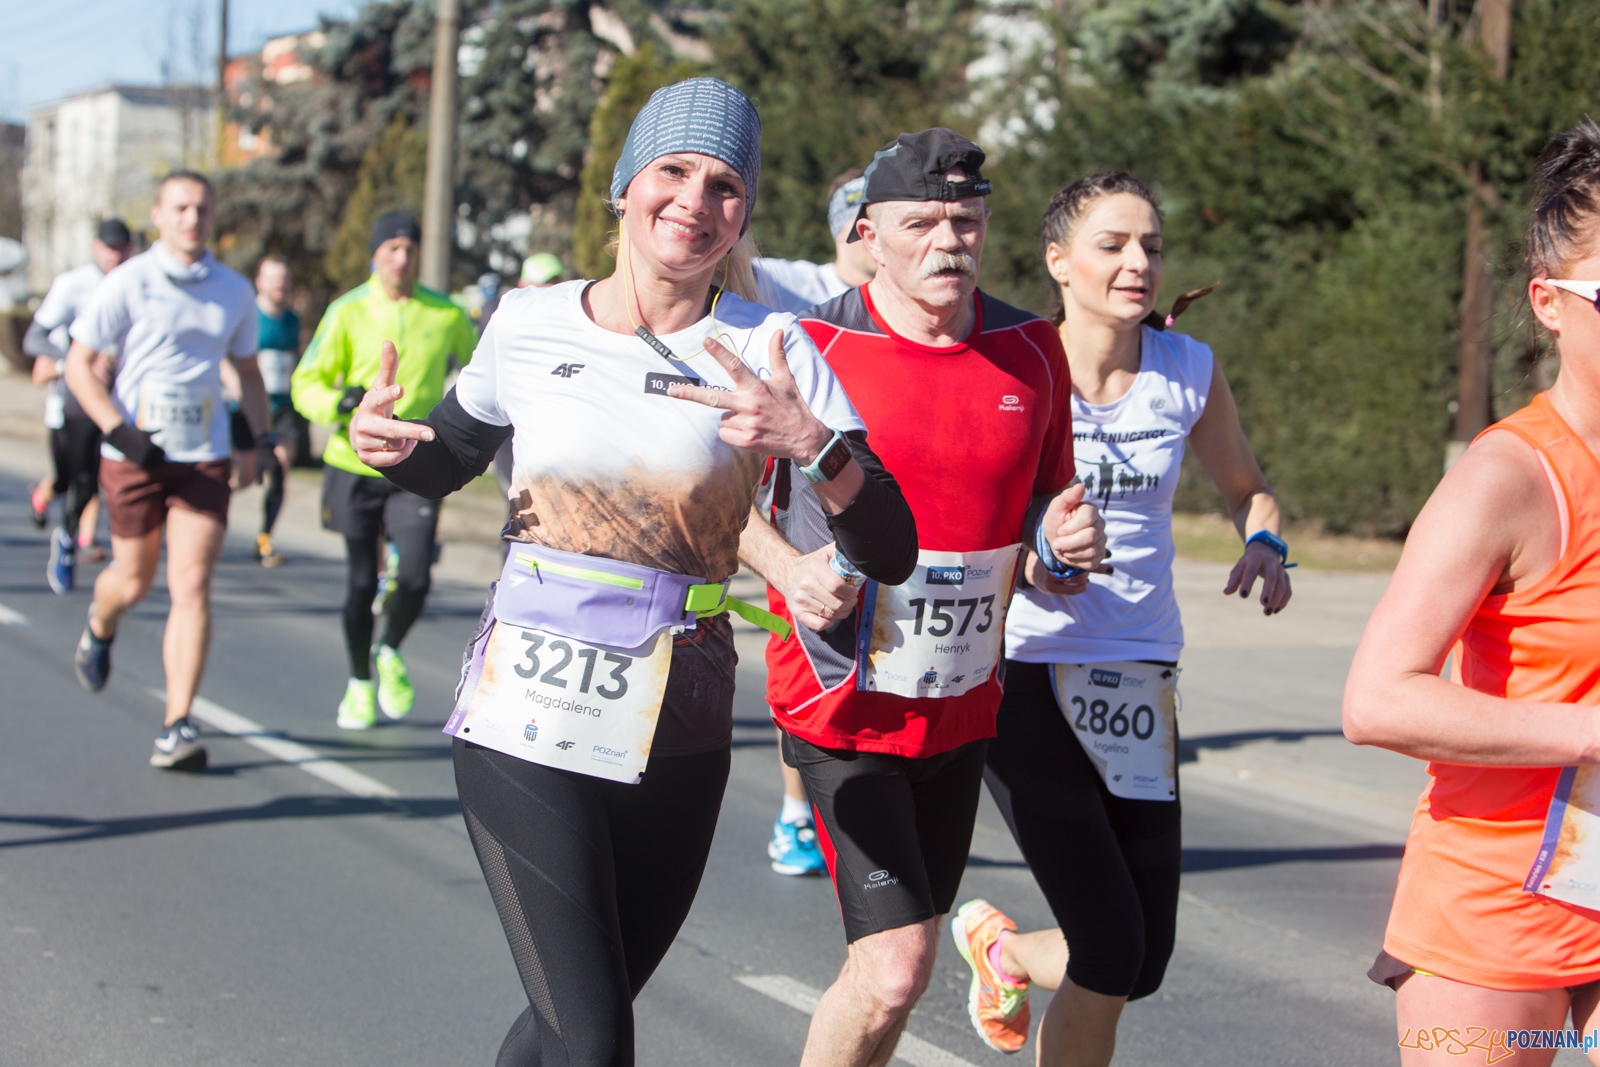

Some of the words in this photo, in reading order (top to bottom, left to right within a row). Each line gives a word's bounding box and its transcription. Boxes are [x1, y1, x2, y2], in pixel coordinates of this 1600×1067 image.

[551, 363, 585, 378] 4F
[998, 404, 1024, 412] Kalenji
[1092, 429, 1167, 444] KENIJCZYCY
[944, 571, 962, 580] PKO
[908, 594, 996, 638] 1573
[934, 642, 971, 655] Henryk
[514, 631, 633, 700] 3213
[1102, 674, 1119, 684] PKO
[525, 688, 602, 718] Magdalena
[1072, 696, 1154, 740] 2860
[555, 740, 576, 750] 4F
[1094, 740, 1129, 754] Angelina
[864, 876, 898, 890] Kalenji
